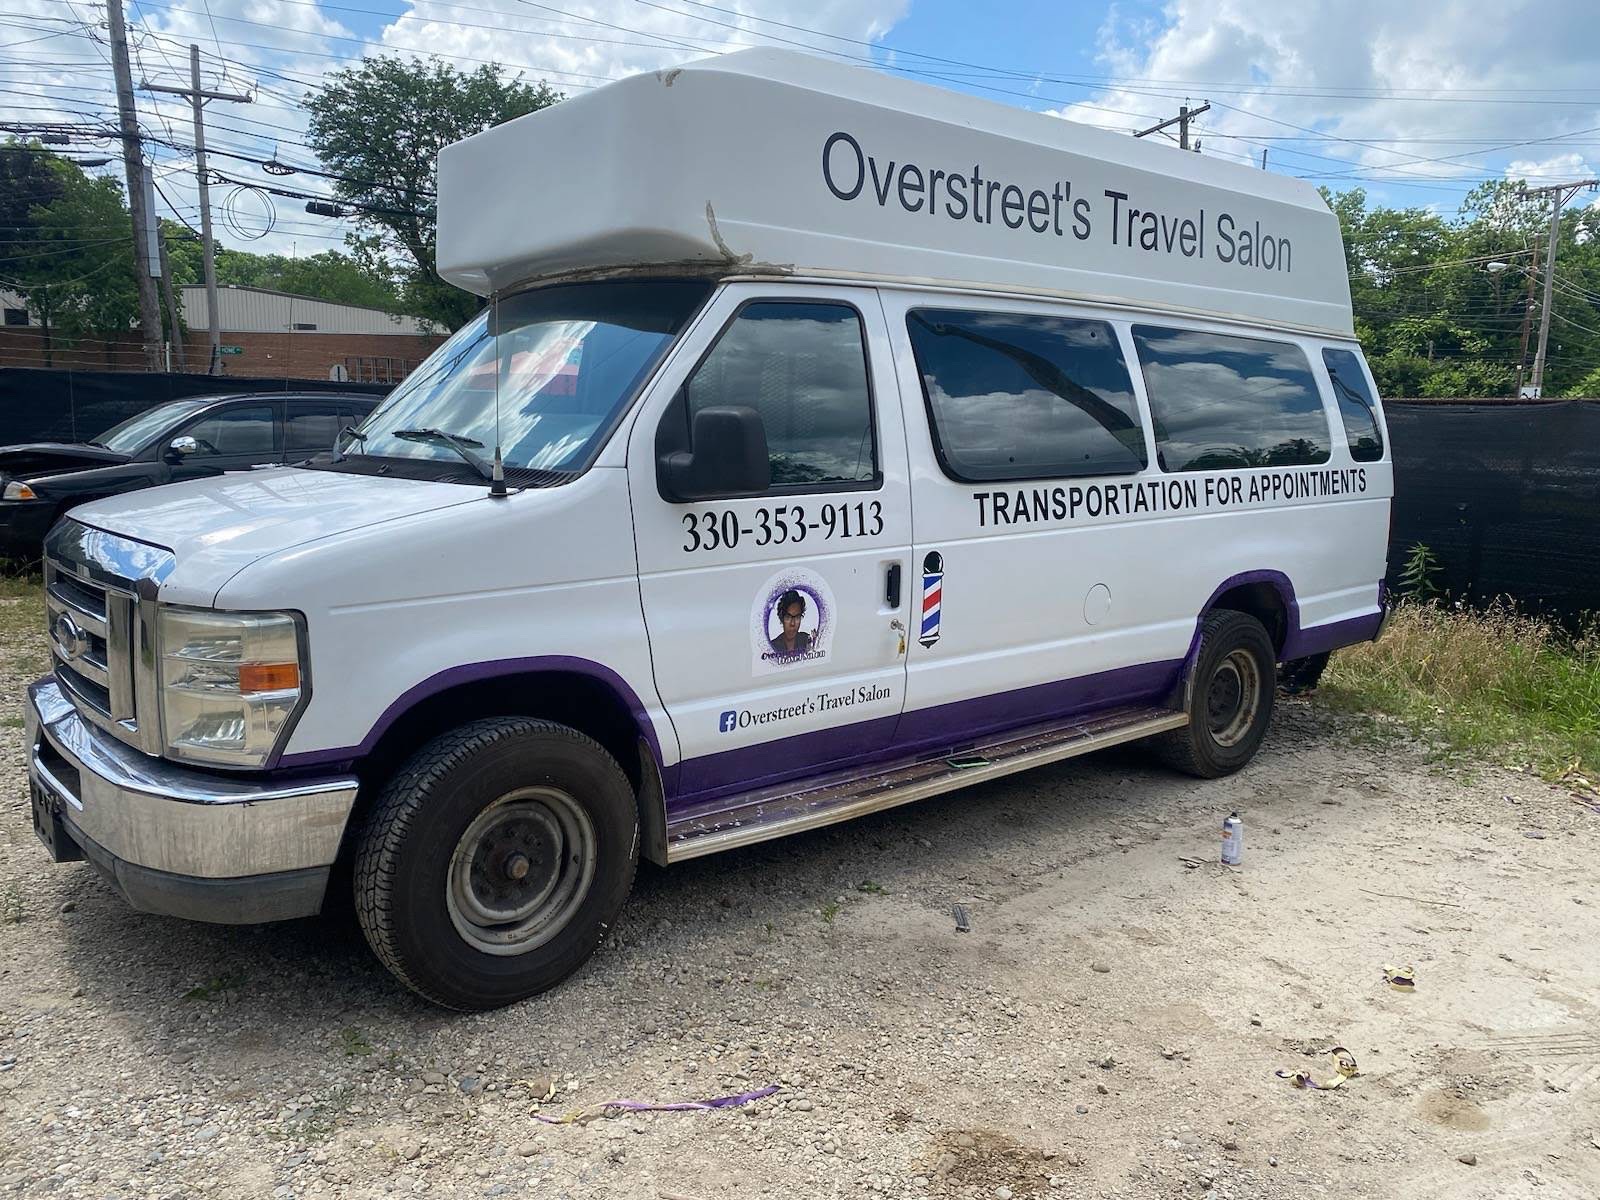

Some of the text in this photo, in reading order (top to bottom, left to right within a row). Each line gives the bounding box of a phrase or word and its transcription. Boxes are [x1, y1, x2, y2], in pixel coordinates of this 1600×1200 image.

[822, 131, 1291, 273] Overstreet's Travel Salon
[973, 468, 1366, 527] TRANSPORTATION FOR APPOINTMENTS
[682, 500, 884, 553] 330-353-9113
[738, 697, 815, 728] Overstreet's
[816, 688, 855, 712] Travel
[858, 684, 891, 704] Salon
